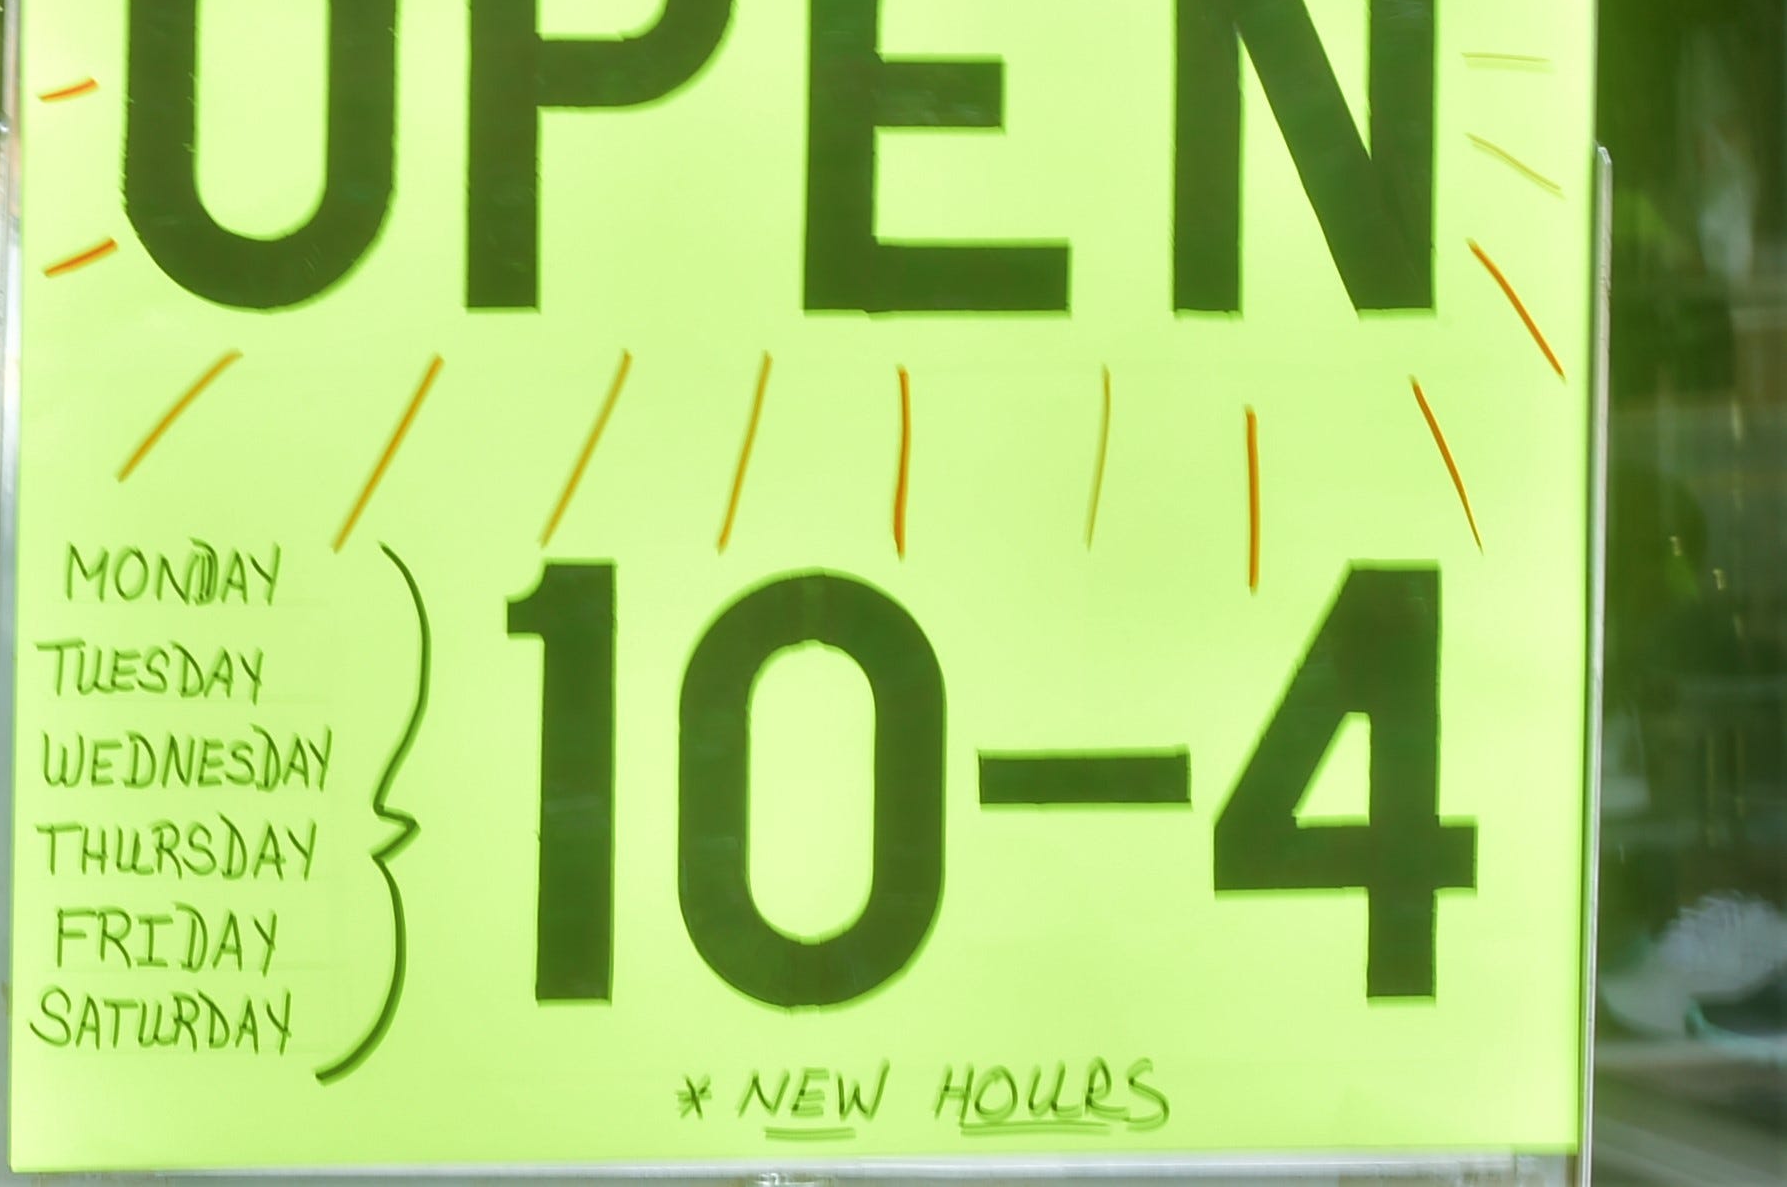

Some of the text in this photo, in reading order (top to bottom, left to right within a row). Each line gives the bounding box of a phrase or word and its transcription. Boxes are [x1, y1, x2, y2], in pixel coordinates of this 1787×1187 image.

[64, 537, 282, 607] MONDAY
[34, 638, 265, 705] TUESDAY
[41, 723, 333, 792] WEDNESDAY
[506, 561, 1477, 1010] 10-4
[35, 812, 318, 881] THURSDAY
[56, 901, 279, 978] FRIDAY
[29, 985, 293, 1056] SATURDAY
[737, 1056, 1172, 1132] NEW HOURS
